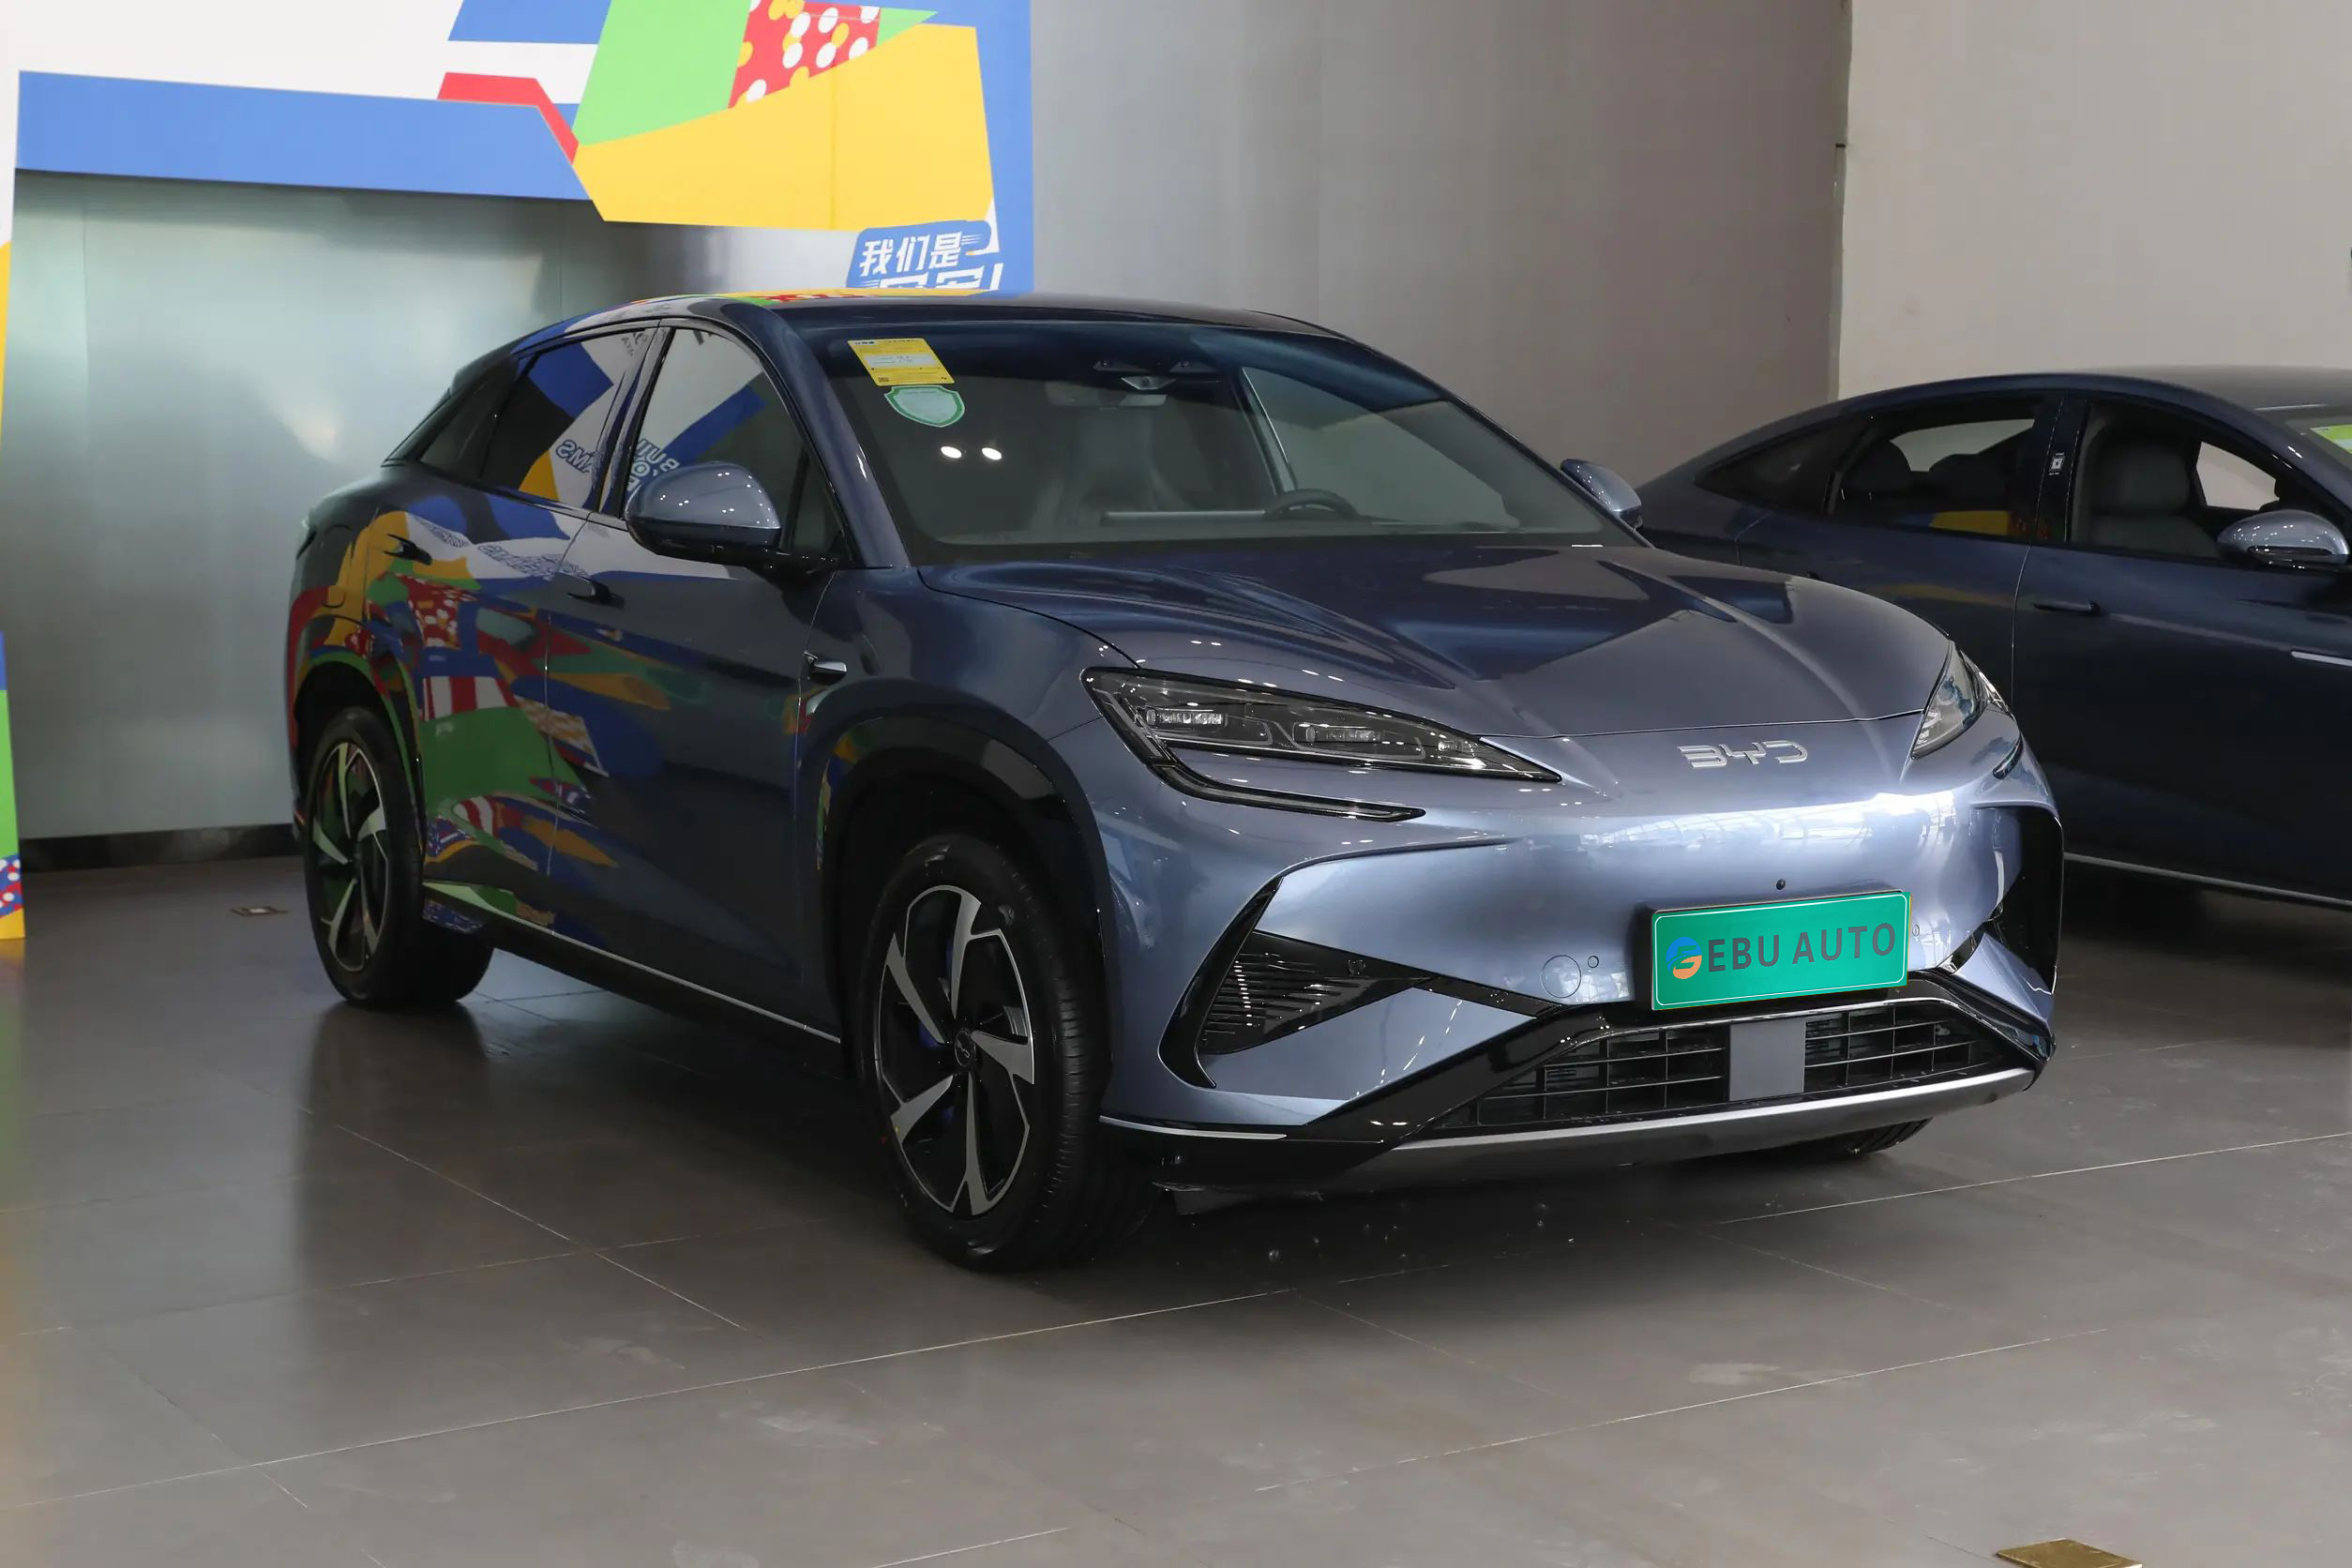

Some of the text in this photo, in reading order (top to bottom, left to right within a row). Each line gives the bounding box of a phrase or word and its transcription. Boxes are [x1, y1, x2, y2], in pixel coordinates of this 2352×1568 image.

[859, 231, 962, 277] 我们是
[1677, 740, 1808, 768] BYD
[1791, 922, 1896, 965] AUTO
